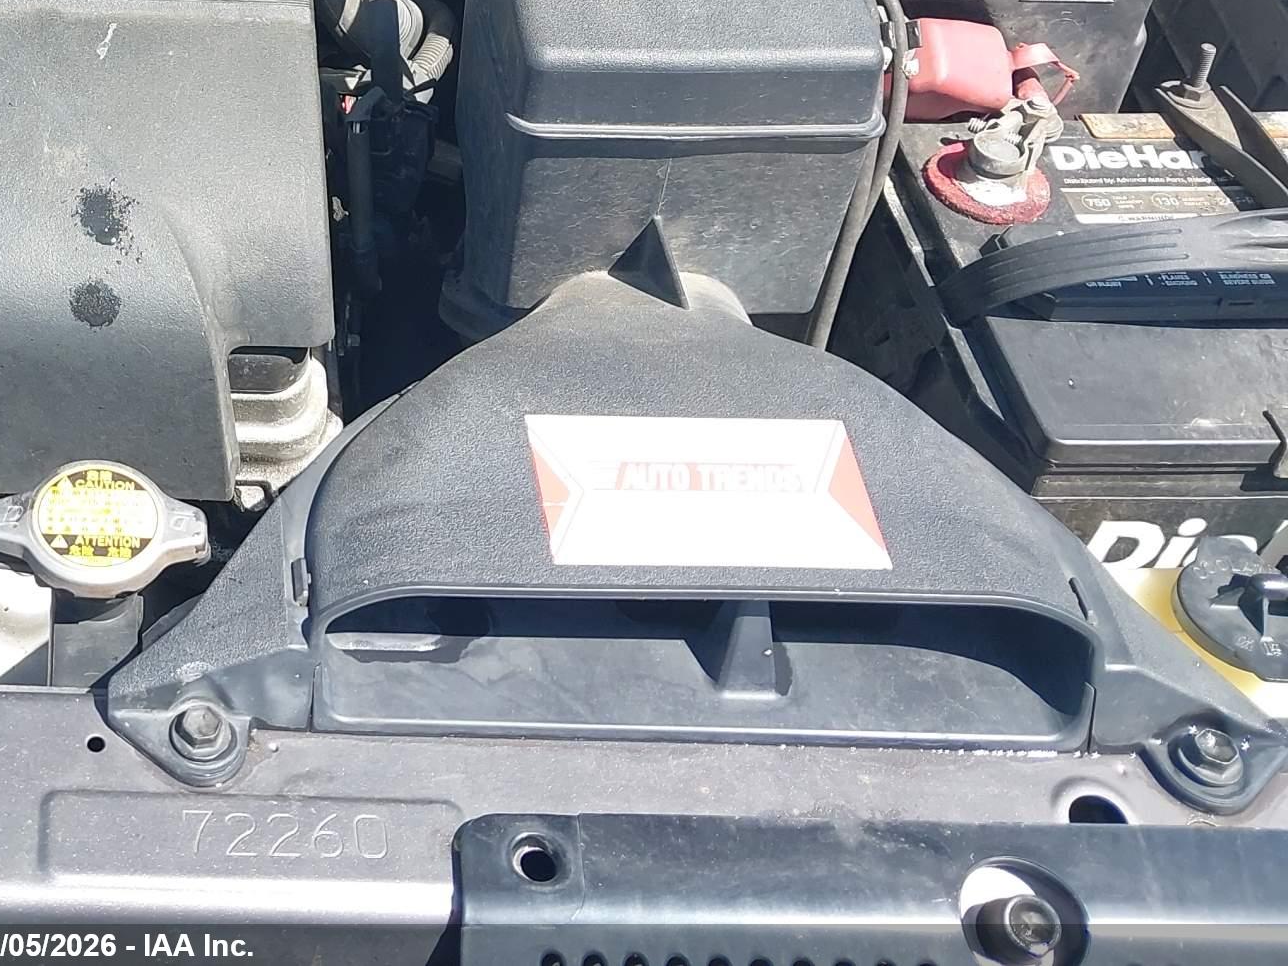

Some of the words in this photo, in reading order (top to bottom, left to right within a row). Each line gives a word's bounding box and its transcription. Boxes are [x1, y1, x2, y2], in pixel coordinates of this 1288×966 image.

[1049, 144, 1204, 171] DieHar
[75, 479, 136, 491] CAUTION
[621, 463, 691, 491] AUTO
[74, 535, 141, 549] ATTENTION
[182, 810, 389, 859] 72260
